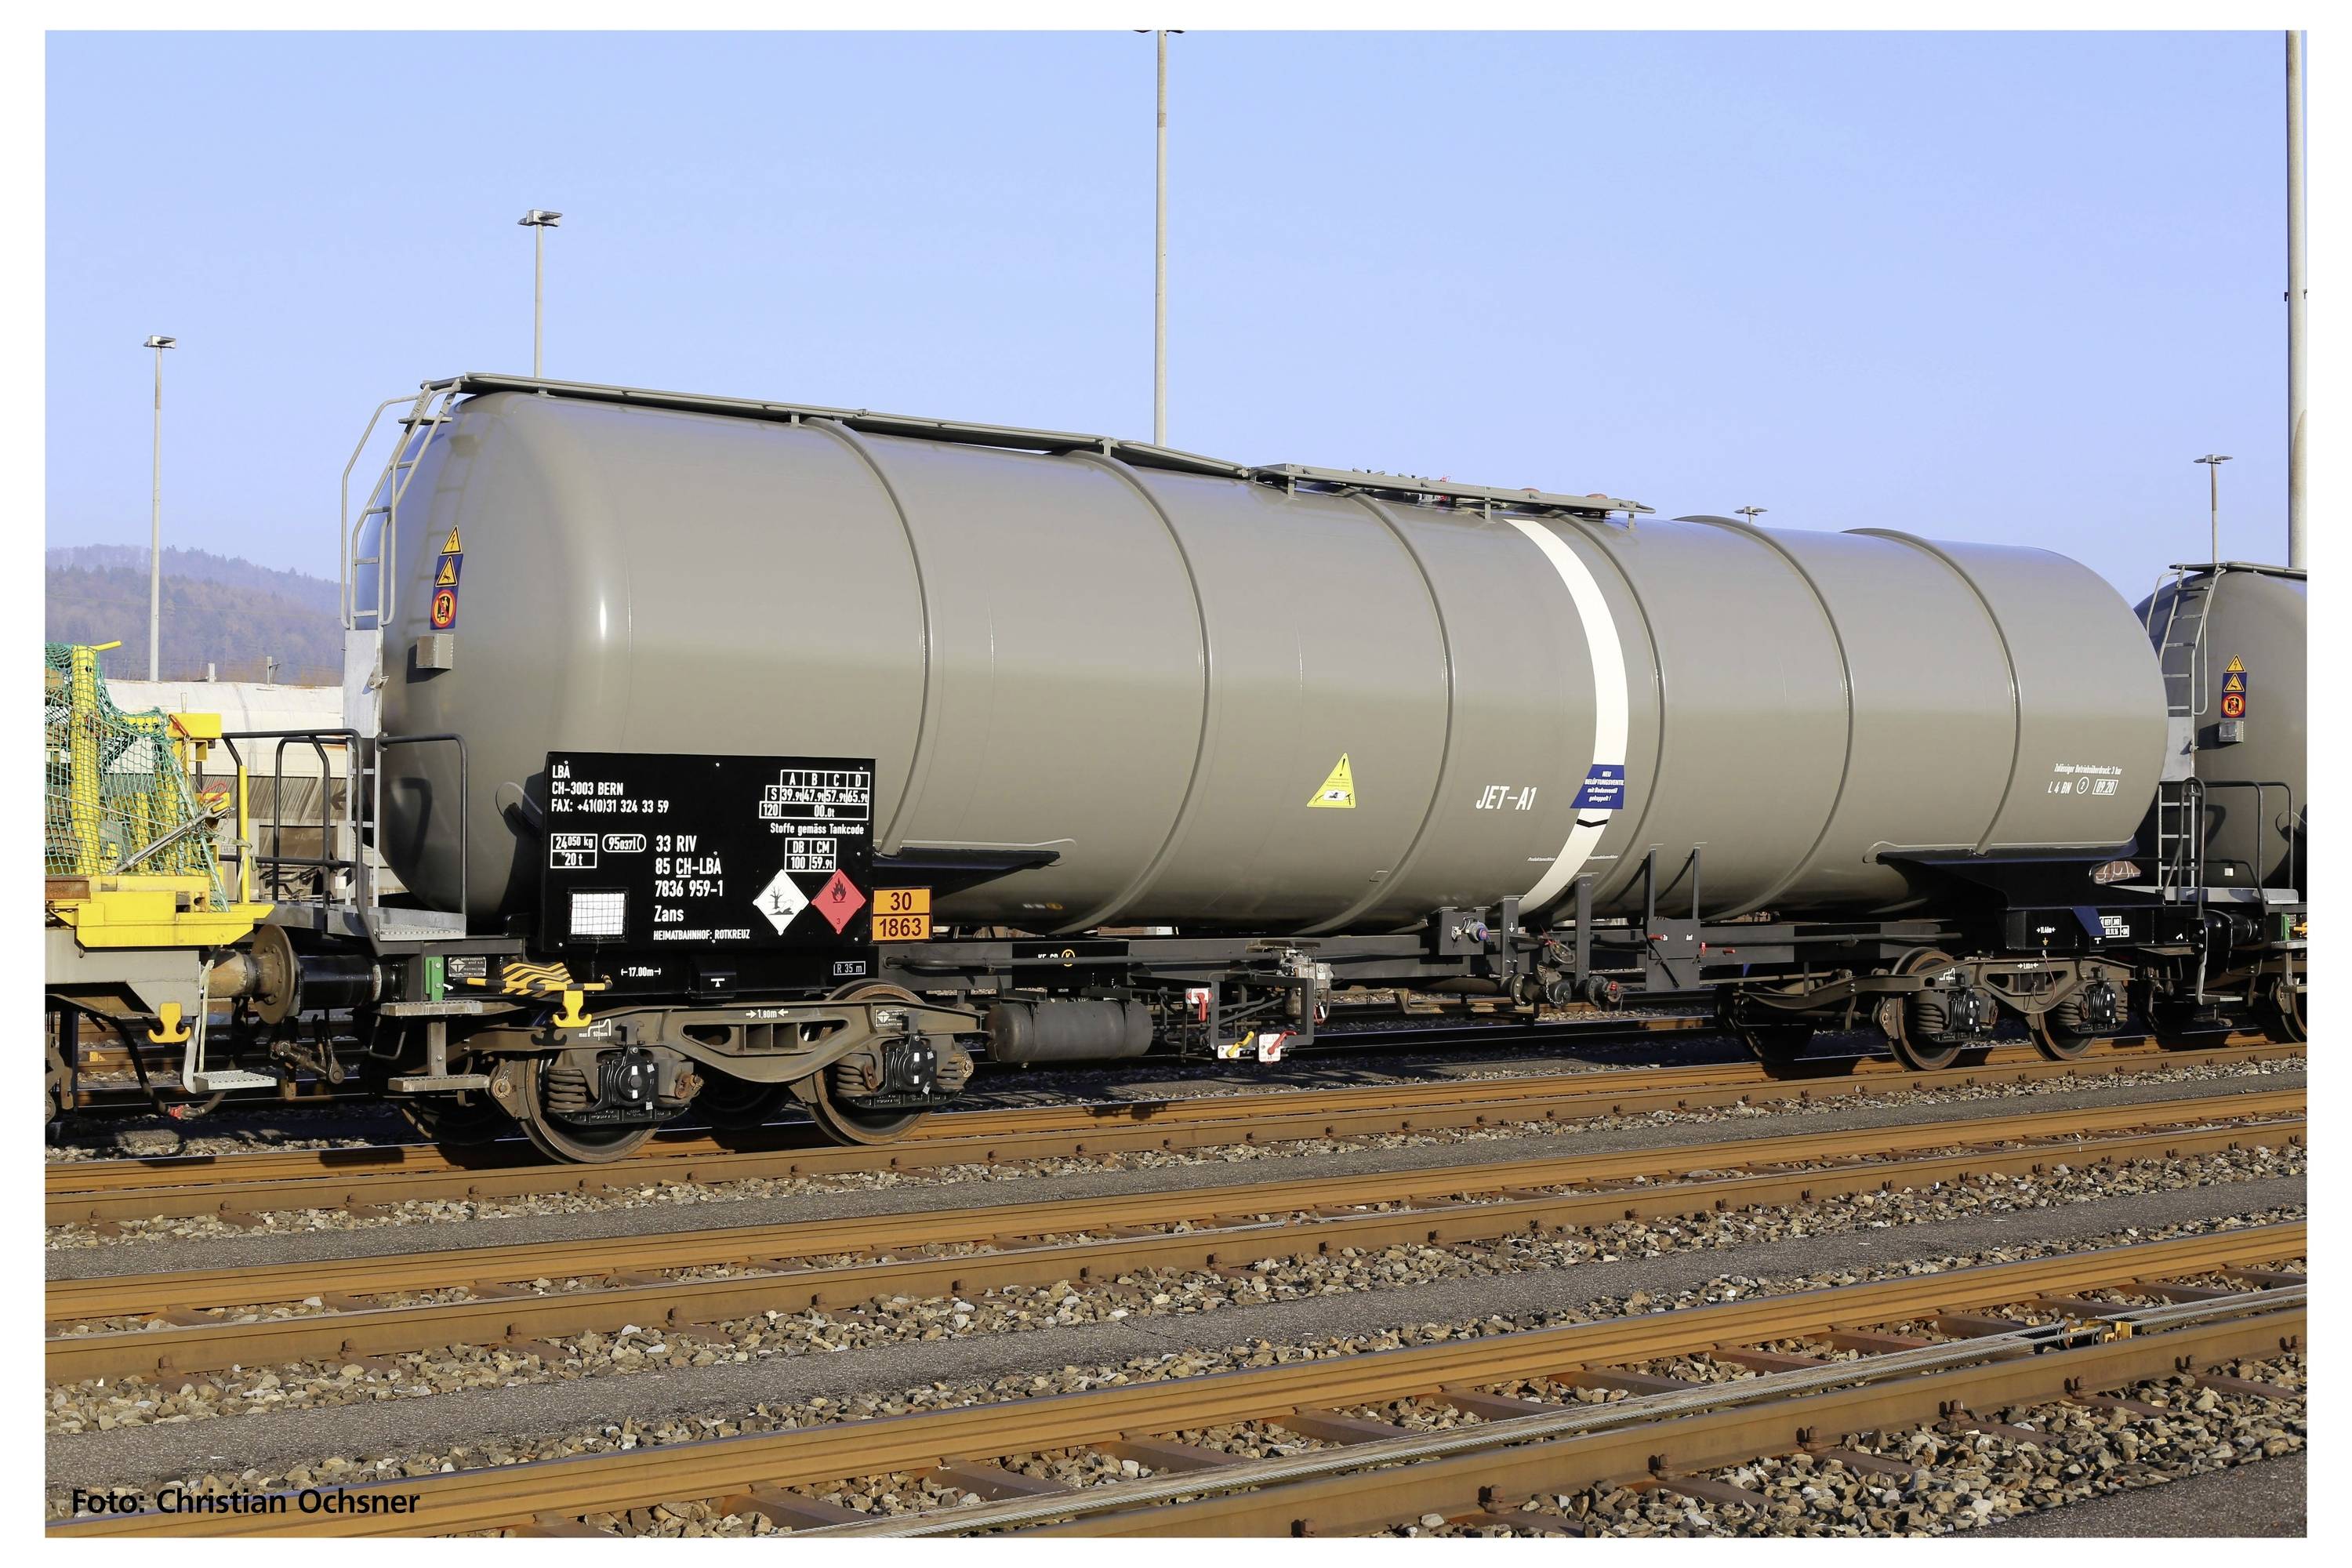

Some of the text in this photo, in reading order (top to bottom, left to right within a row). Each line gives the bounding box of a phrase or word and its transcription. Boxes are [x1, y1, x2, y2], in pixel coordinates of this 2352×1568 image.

[789, 772, 862, 787] A B C D
[552, 782, 624, 796] CH-3003 BERN
[771, 787, 778, 800] S
[1475, 786, 1537, 810] JET-A1
[551, 798, 670, 813] FAX: +41(0)31 324 33 59
[763, 803, 779, 816] 120
[770, 822, 864, 837] Stoffe gemäss Tankcode
[583, 836, 593, 849] kg
[655, 835, 697, 852] 33 RIV
[793, 840, 829, 854] DB CM
[564, 852, 583, 866] 20 t
[790, 856, 806, 869] 100
[655, 857, 722, 876] 85 CH-LBA
[655, 880, 724, 897] 7836 959-1
[890, 891, 912, 911] 30
[654, 905, 684, 922] Zans
[879, 917, 922, 937] 1863
[653, 929, 750, 941] HEIMATBAHNHOF: ROTKREUZ
[628, 967, 654, 977] 17.00m
[837, 964, 842, 974] R
[844, 963, 853, 973] 35
